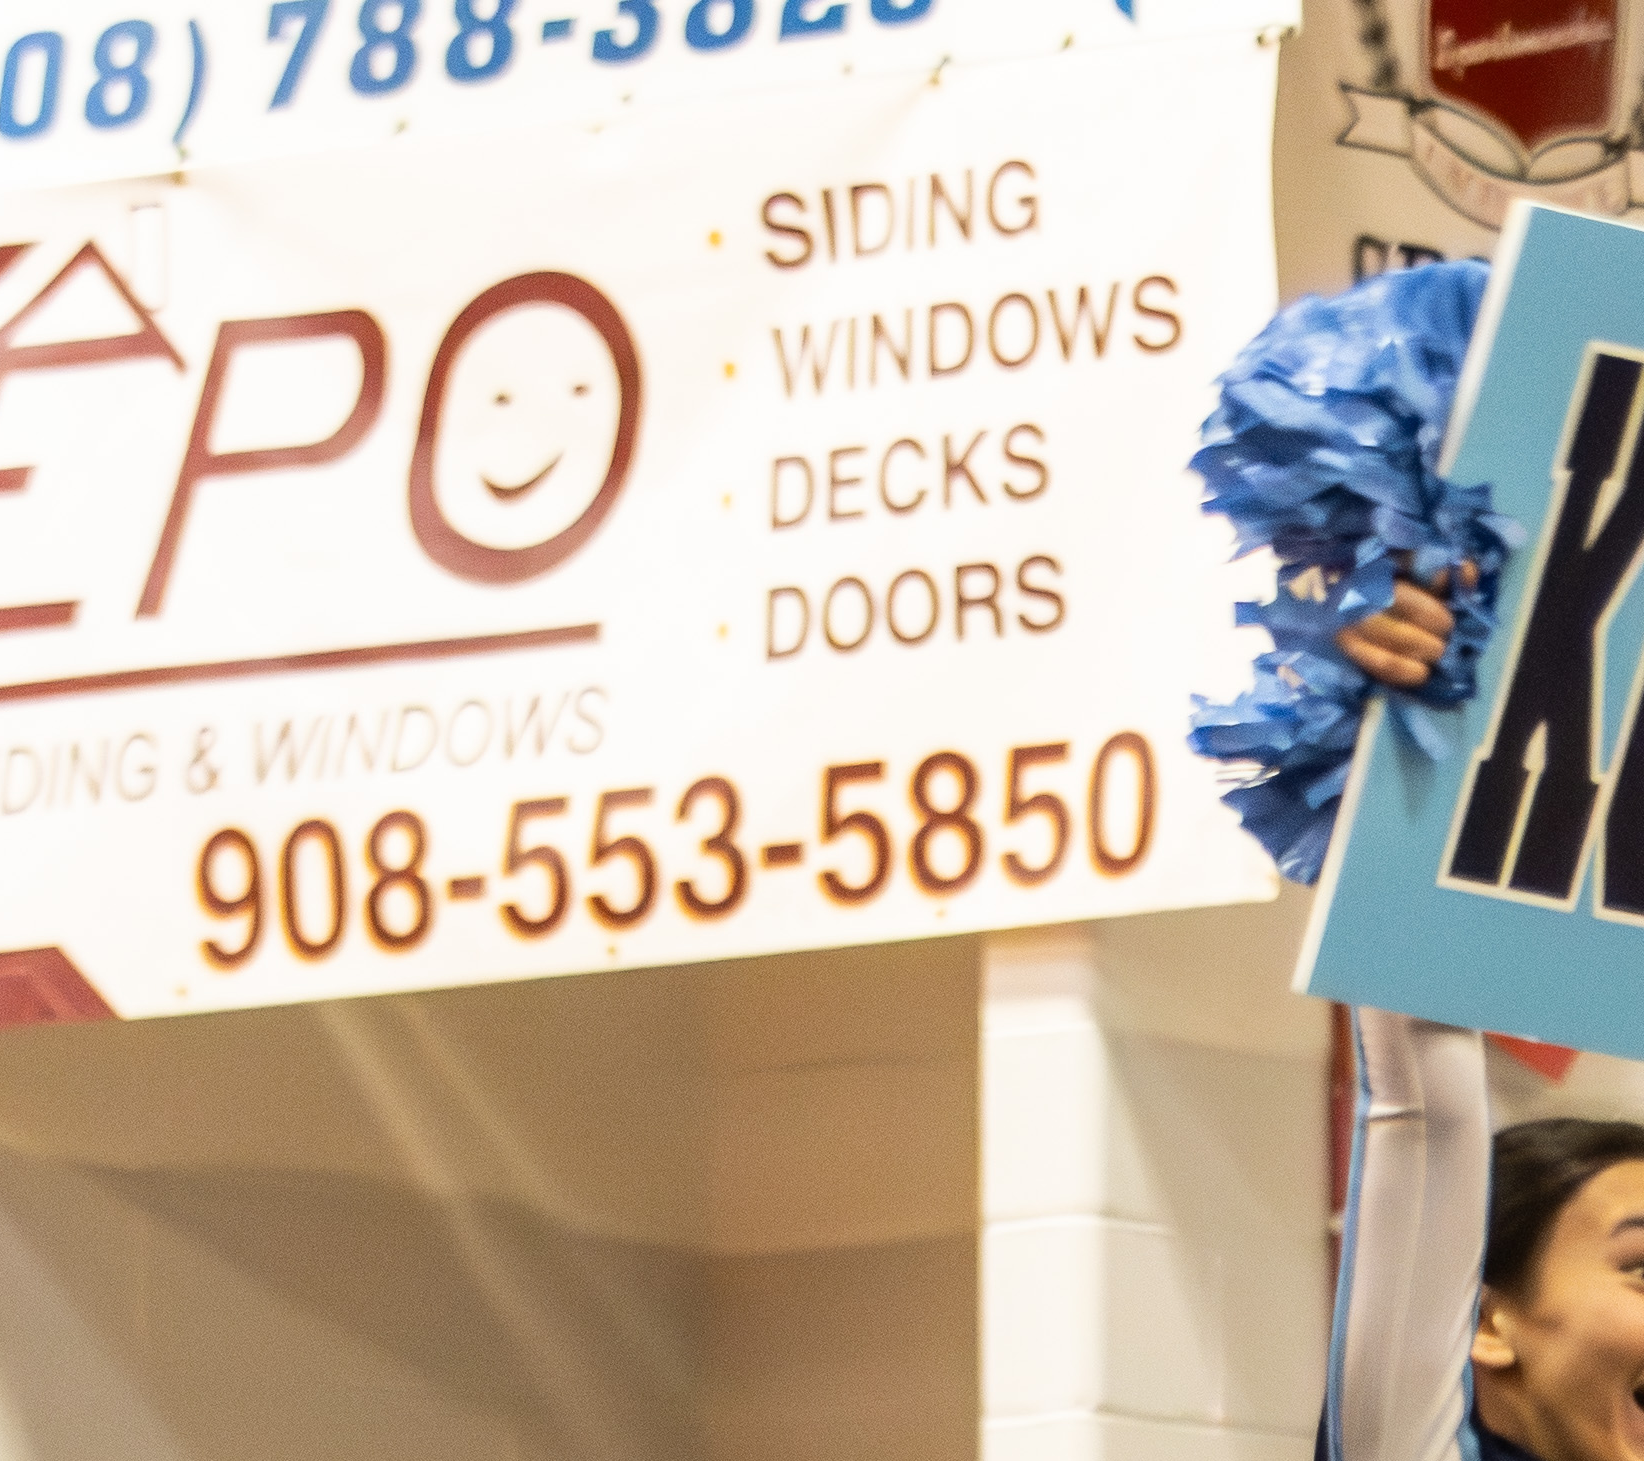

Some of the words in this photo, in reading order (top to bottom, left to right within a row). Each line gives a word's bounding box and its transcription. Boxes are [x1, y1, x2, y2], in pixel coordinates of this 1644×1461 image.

[759, 159, 1038, 272] SIDING
[772, 273, 1183, 394] WINDOWS
[770, 422, 1050, 531] DECKS
[766, 553, 1066, 661] DOORS
[187, 726, 220, 795] &
[253, 684, 606, 786] WINDOWS
[195, 731, 1160, 972] 908-553-5850
